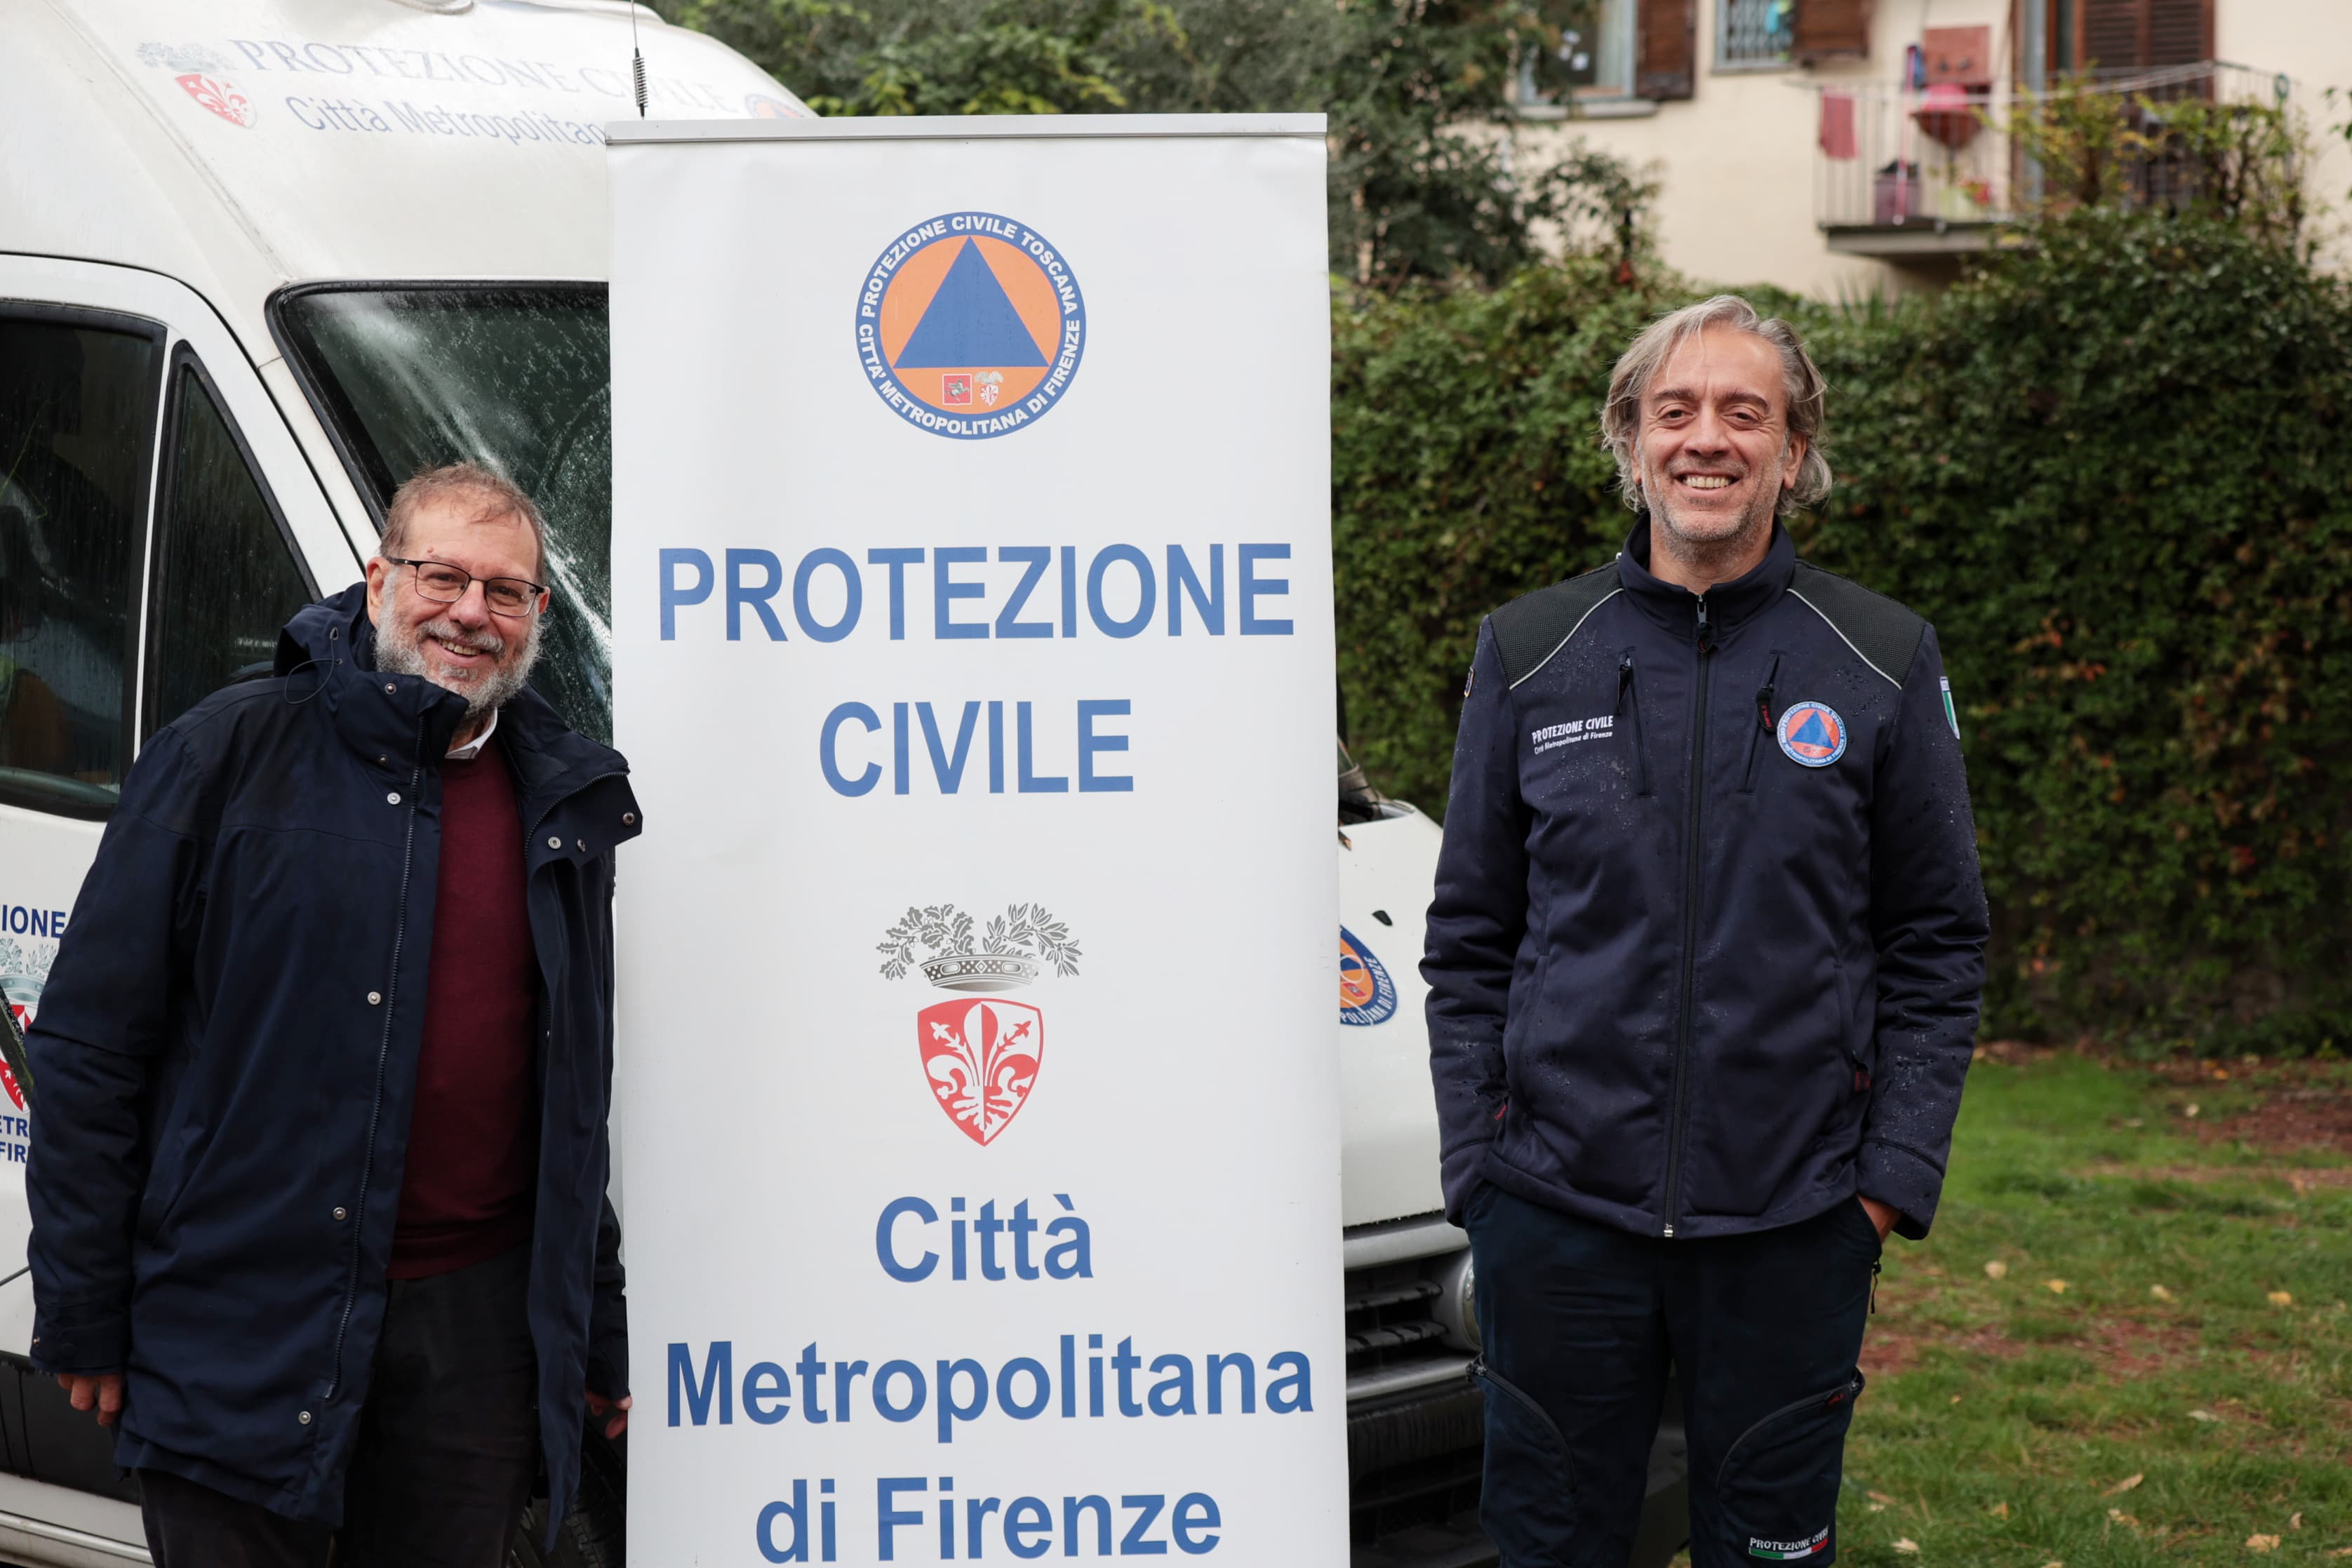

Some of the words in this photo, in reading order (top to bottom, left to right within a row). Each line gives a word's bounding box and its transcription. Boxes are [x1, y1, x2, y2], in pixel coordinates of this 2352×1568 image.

[227, 39, 582, 93] PROTEZIONE
[284, 94, 393, 133] Città
[861, 219, 947, 319] PROTEZIONE
[951, 215, 1018, 240] CIVILE
[1020, 231, 1078, 316] TOSCANA
[859, 323, 887, 379] CITTA'
[879, 379, 1029, 436] METROPOLITANA
[1027, 393, 1049, 413] DI
[1046, 319, 1081, 397] FIRENZE
[659, 543, 1294, 643] PROTEZIONE
[820, 699, 1134, 797] CIVILE
[1532, 721, 1584, 745] PROTEZIONE
[1585, 716, 1614, 730] CIVILE
[1363, 956, 1393, 998] FIRENZE
[1377, 996, 1393, 1010] DI
[876, 1193, 1094, 1282] Città
[667, 1334, 1314, 1443] Metropolitana
[756, 1478, 836, 1564] di
[877, 1476, 1221, 1561] Firenze
[1749, 1536, 1811, 1551] PROTEZIONE
